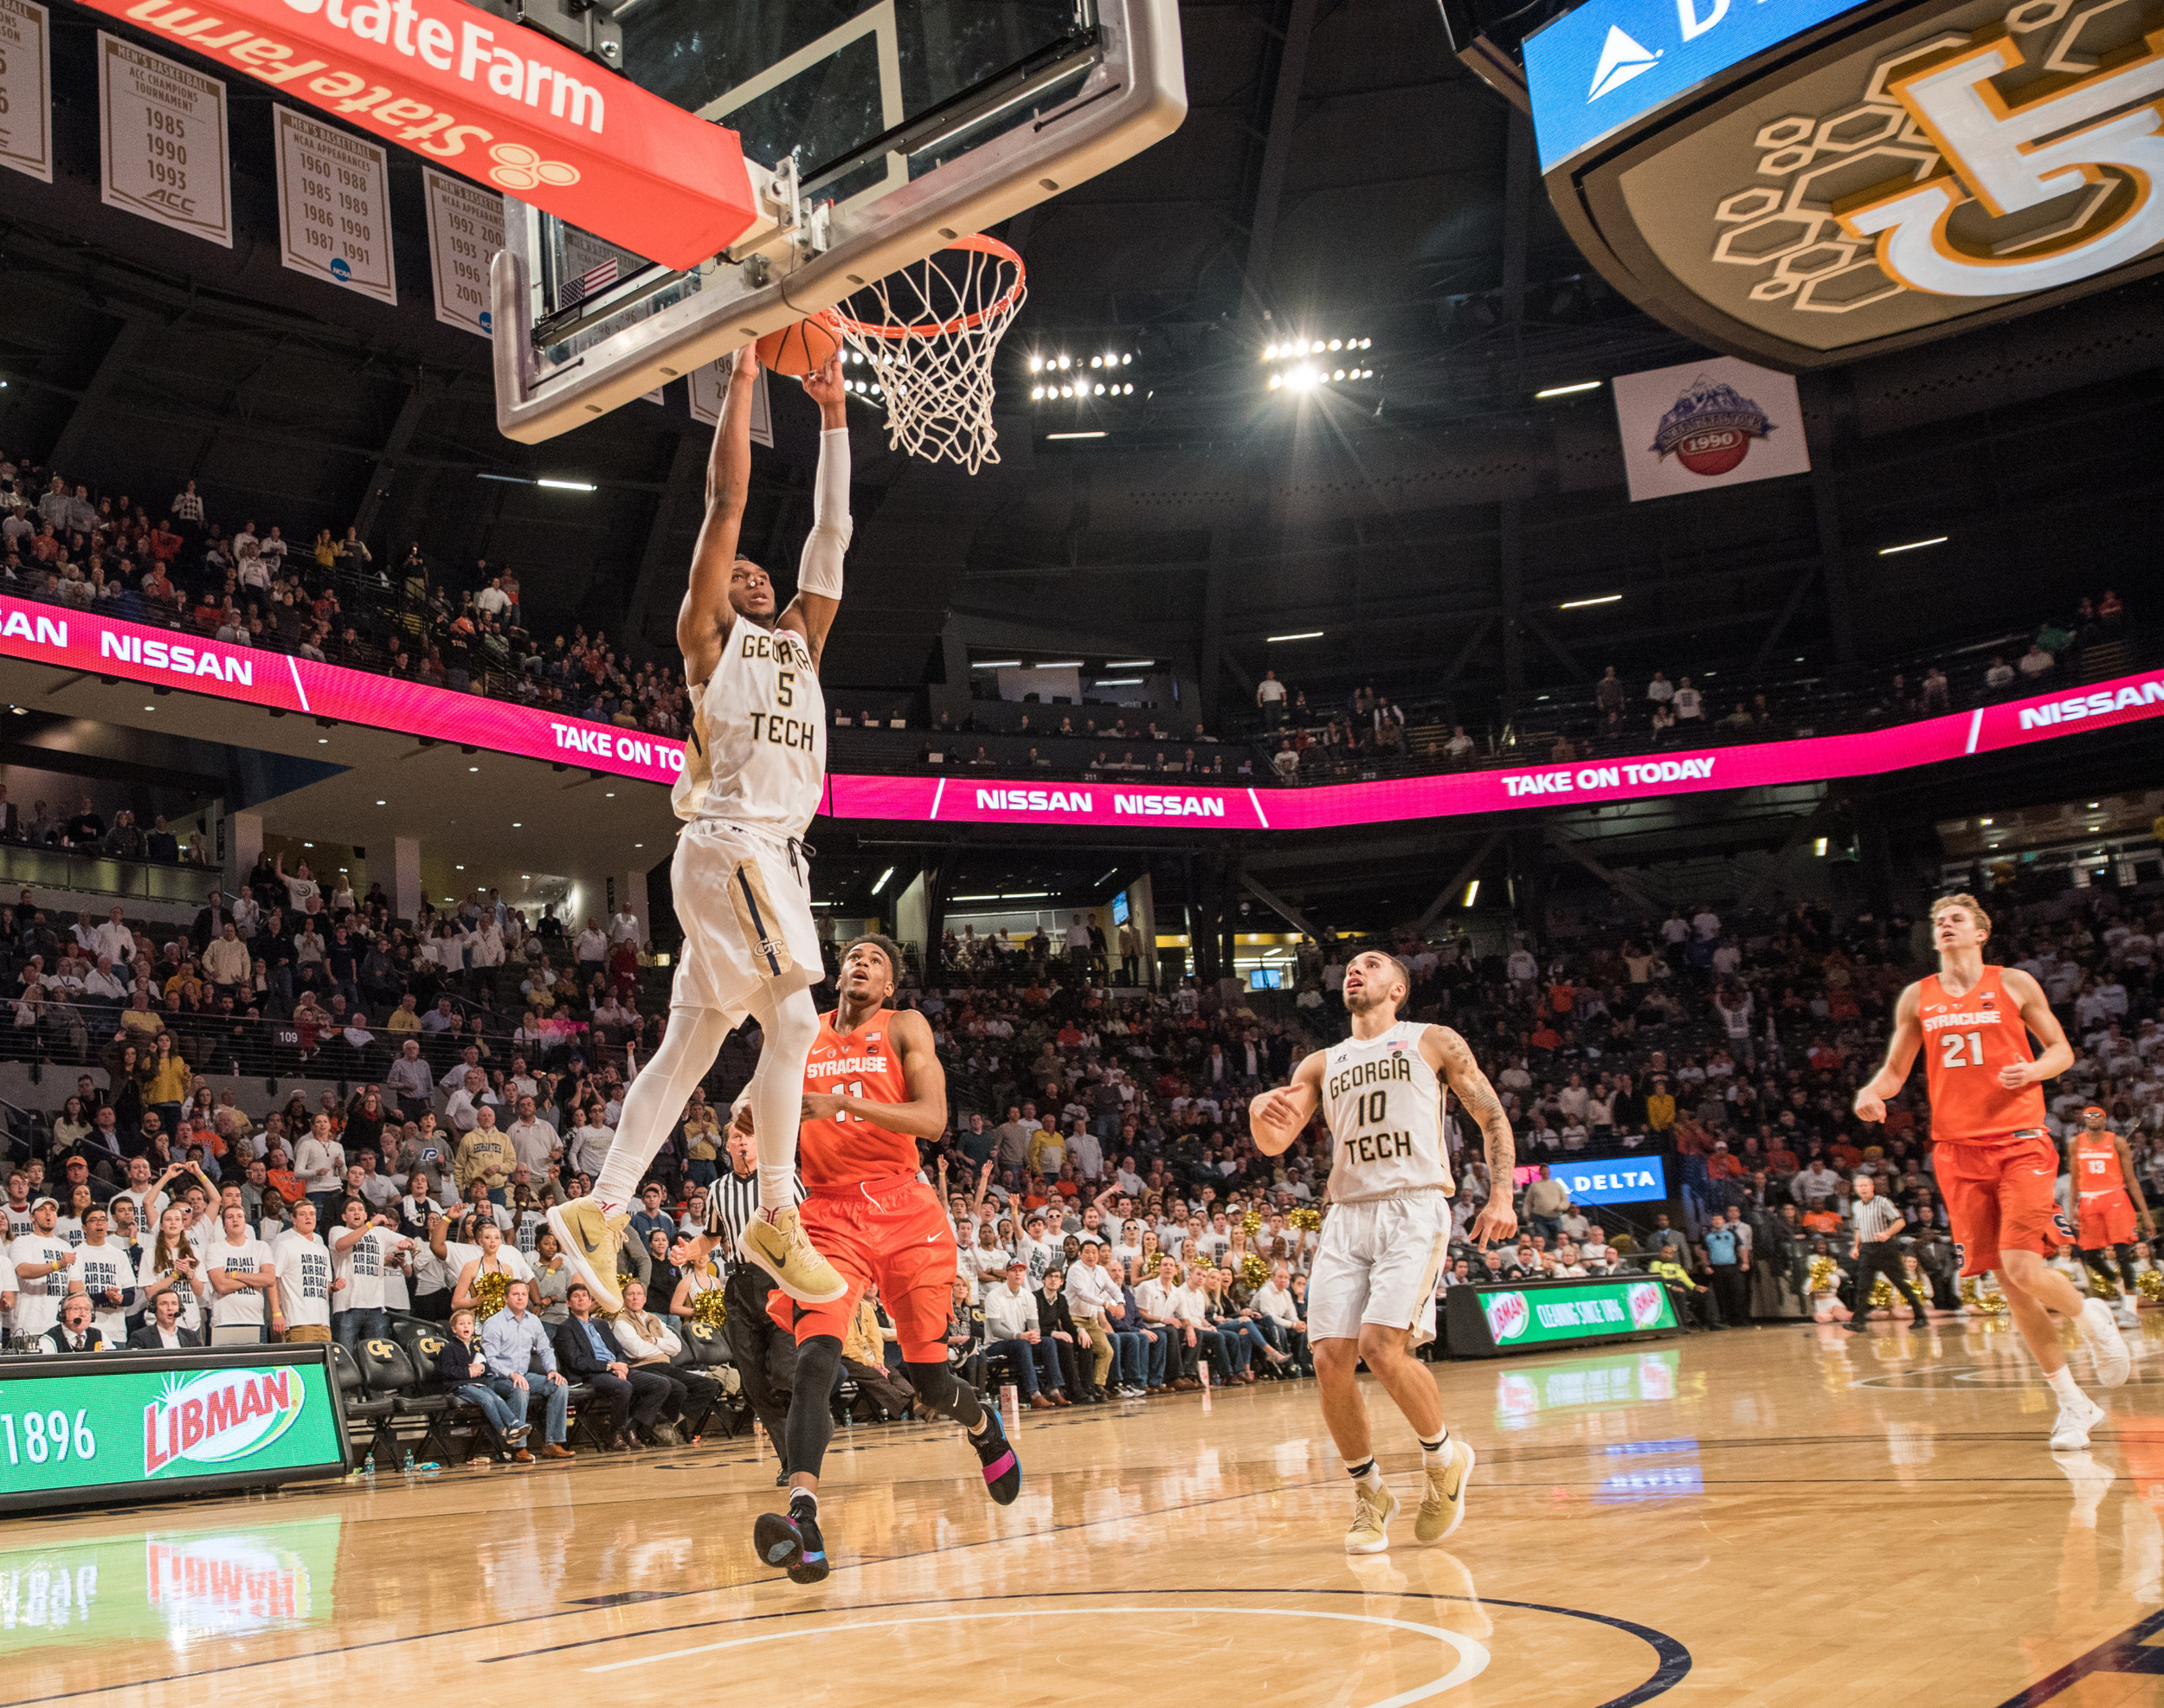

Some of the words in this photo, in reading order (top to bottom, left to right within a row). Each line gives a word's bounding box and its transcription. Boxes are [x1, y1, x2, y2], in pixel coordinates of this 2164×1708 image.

[130, 67, 145, 81] ACC
[148, 73, 198, 103] CHAMPIONS
[151, 55, 209, 93] BASKETBALL
[135, 81, 192, 113] TOURNAMENT
[145, 106, 184, 139] 1985
[146, 132, 187, 165] 1990
[293, 132, 314, 150] NCAA
[317, 141, 370, 172] APPEARANCES
[147, 159, 187, 190] 1993
[300, 152, 331, 178] 1960
[338, 167, 367, 193] 1988
[144, 188, 196, 214] ACC
[302, 177, 332, 202] 1985
[338, 192, 368, 216] 1989
[441, 194, 460, 210] NCAA
[304, 203, 333, 228] 1986
[341, 217, 370, 242] 1990
[448, 213, 474, 236] 1992
[482, 227, 506, 247] 200
[306, 228, 333, 251] 1987
[342, 242, 370, 265] 1991
[450, 236, 477, 260] 1993
[453, 260, 480, 283] 1996
[456, 284, 483, 306] 2001
[1689, 432, 1734, 451] 1990
[101, 630, 253, 686] NISSAN
[777, 671, 795, 708] 5
[551, 723, 613, 757] TAKE
[616, 738, 652, 765] ON
[750, 712, 815, 752] TECH
[1501, 771, 1574, 796] TAKE
[1576, 766, 1620, 790] ON
[1621, 757, 1716, 784] TODAY
[976, 789, 1092, 812] NISSAN
[1114, 794, 1225, 816] NISSAN
[279, 1031, 298, 1043] 109
[1923, 1011, 2001, 1032] SYRACUSE
[1941, 1031, 1985, 1069] 21
[807, 1056, 887, 1080] SYRACUSE
[1330, 1058, 1412, 1100] GEORGIA
[1358, 1090, 1387, 1127] 10
[1344, 1131, 1412, 1164] TECH
[1574, 1171, 1656, 1192] DELTA
[301, 1254, 312, 1265] AIR
[352, 1244, 364, 1254] AIR
[365, 1244, 380, 1254] BALL
[353, 1254, 364, 1264] AIR
[366, 1254, 380, 1266] BALL
[85, 1262, 98, 1273] AIR
[100, 1262, 117, 1274] BALL
[85, 1273, 99, 1285] AIR
[100, 1274, 117, 1286] BALL
[302, 1265, 313, 1275] AIR
[303, 1276, 314, 1286] AIR
[354, 1265, 365, 1274] AIR
[304, 1287, 315, 1298] AIR
[2, 1408, 96, 1466] 1896
[144, 1370, 292, 1477] LIBMAN
